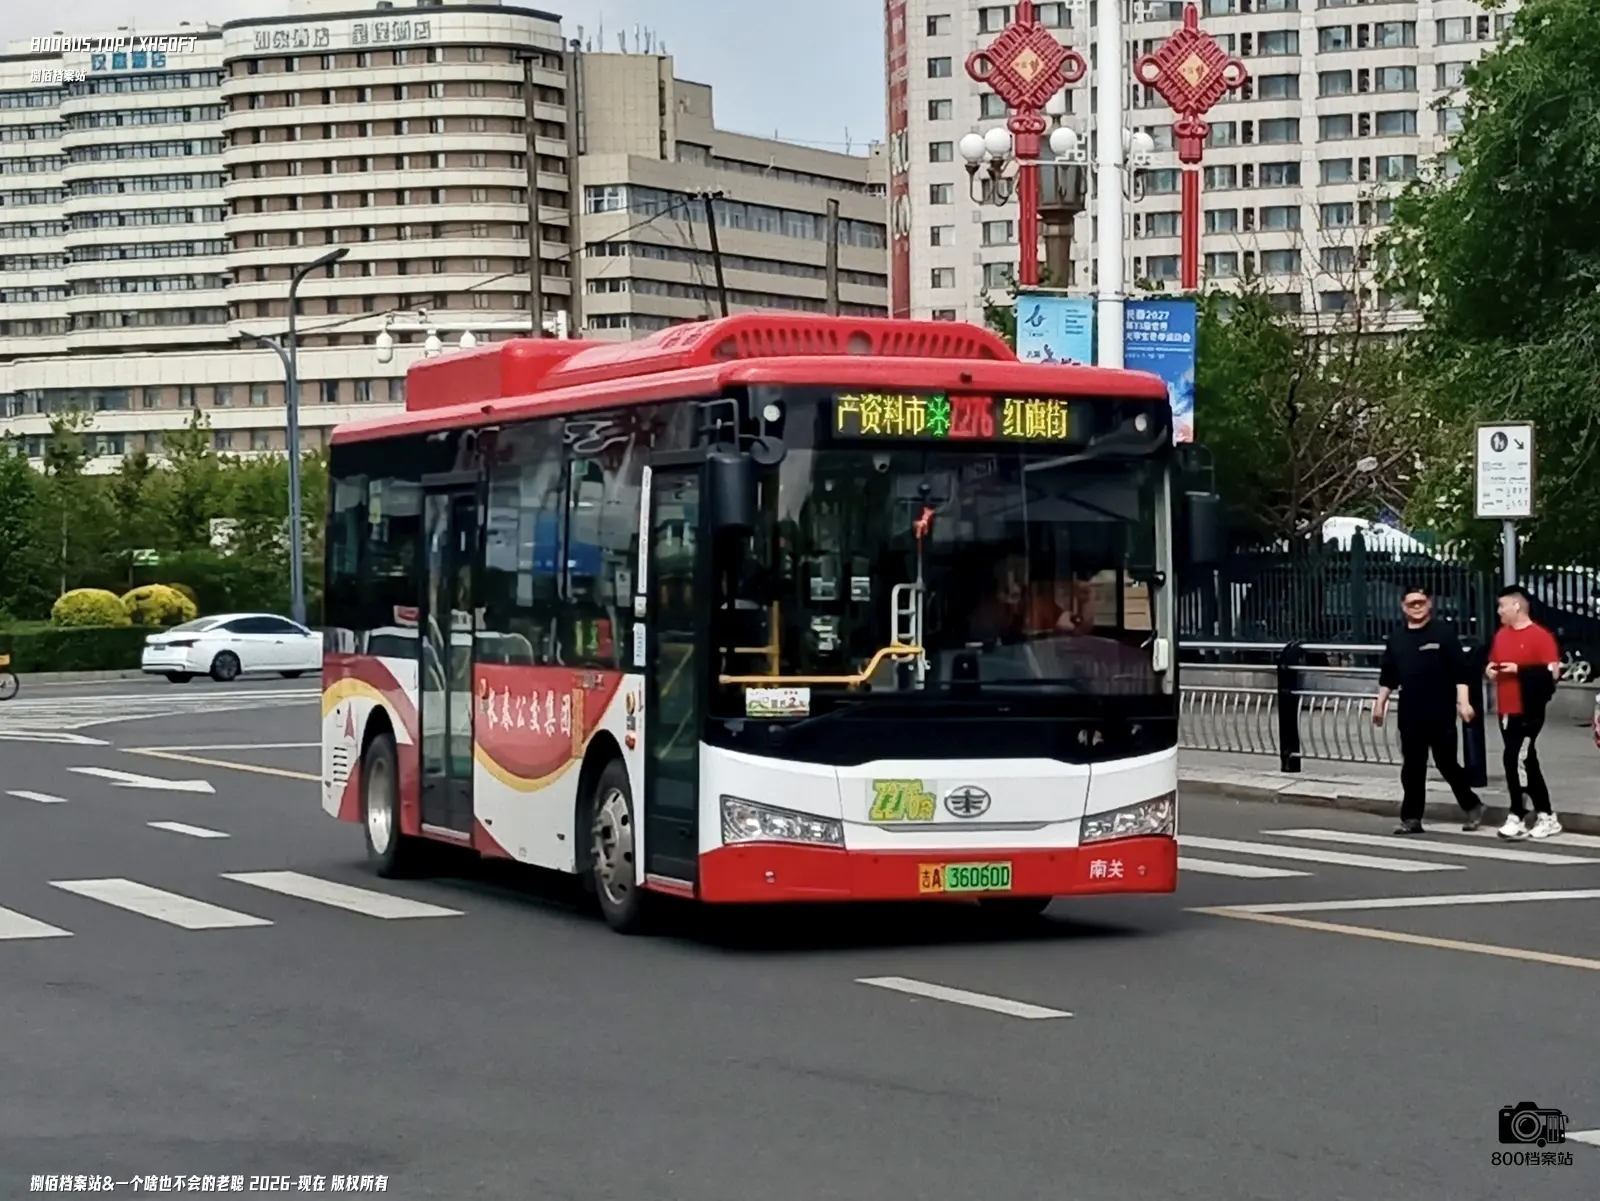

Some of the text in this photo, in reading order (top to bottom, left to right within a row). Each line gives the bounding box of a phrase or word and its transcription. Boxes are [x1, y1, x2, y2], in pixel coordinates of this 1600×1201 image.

[1003, 398, 1068, 439] 红旗街
[1090, 859, 1124, 879] 南关
